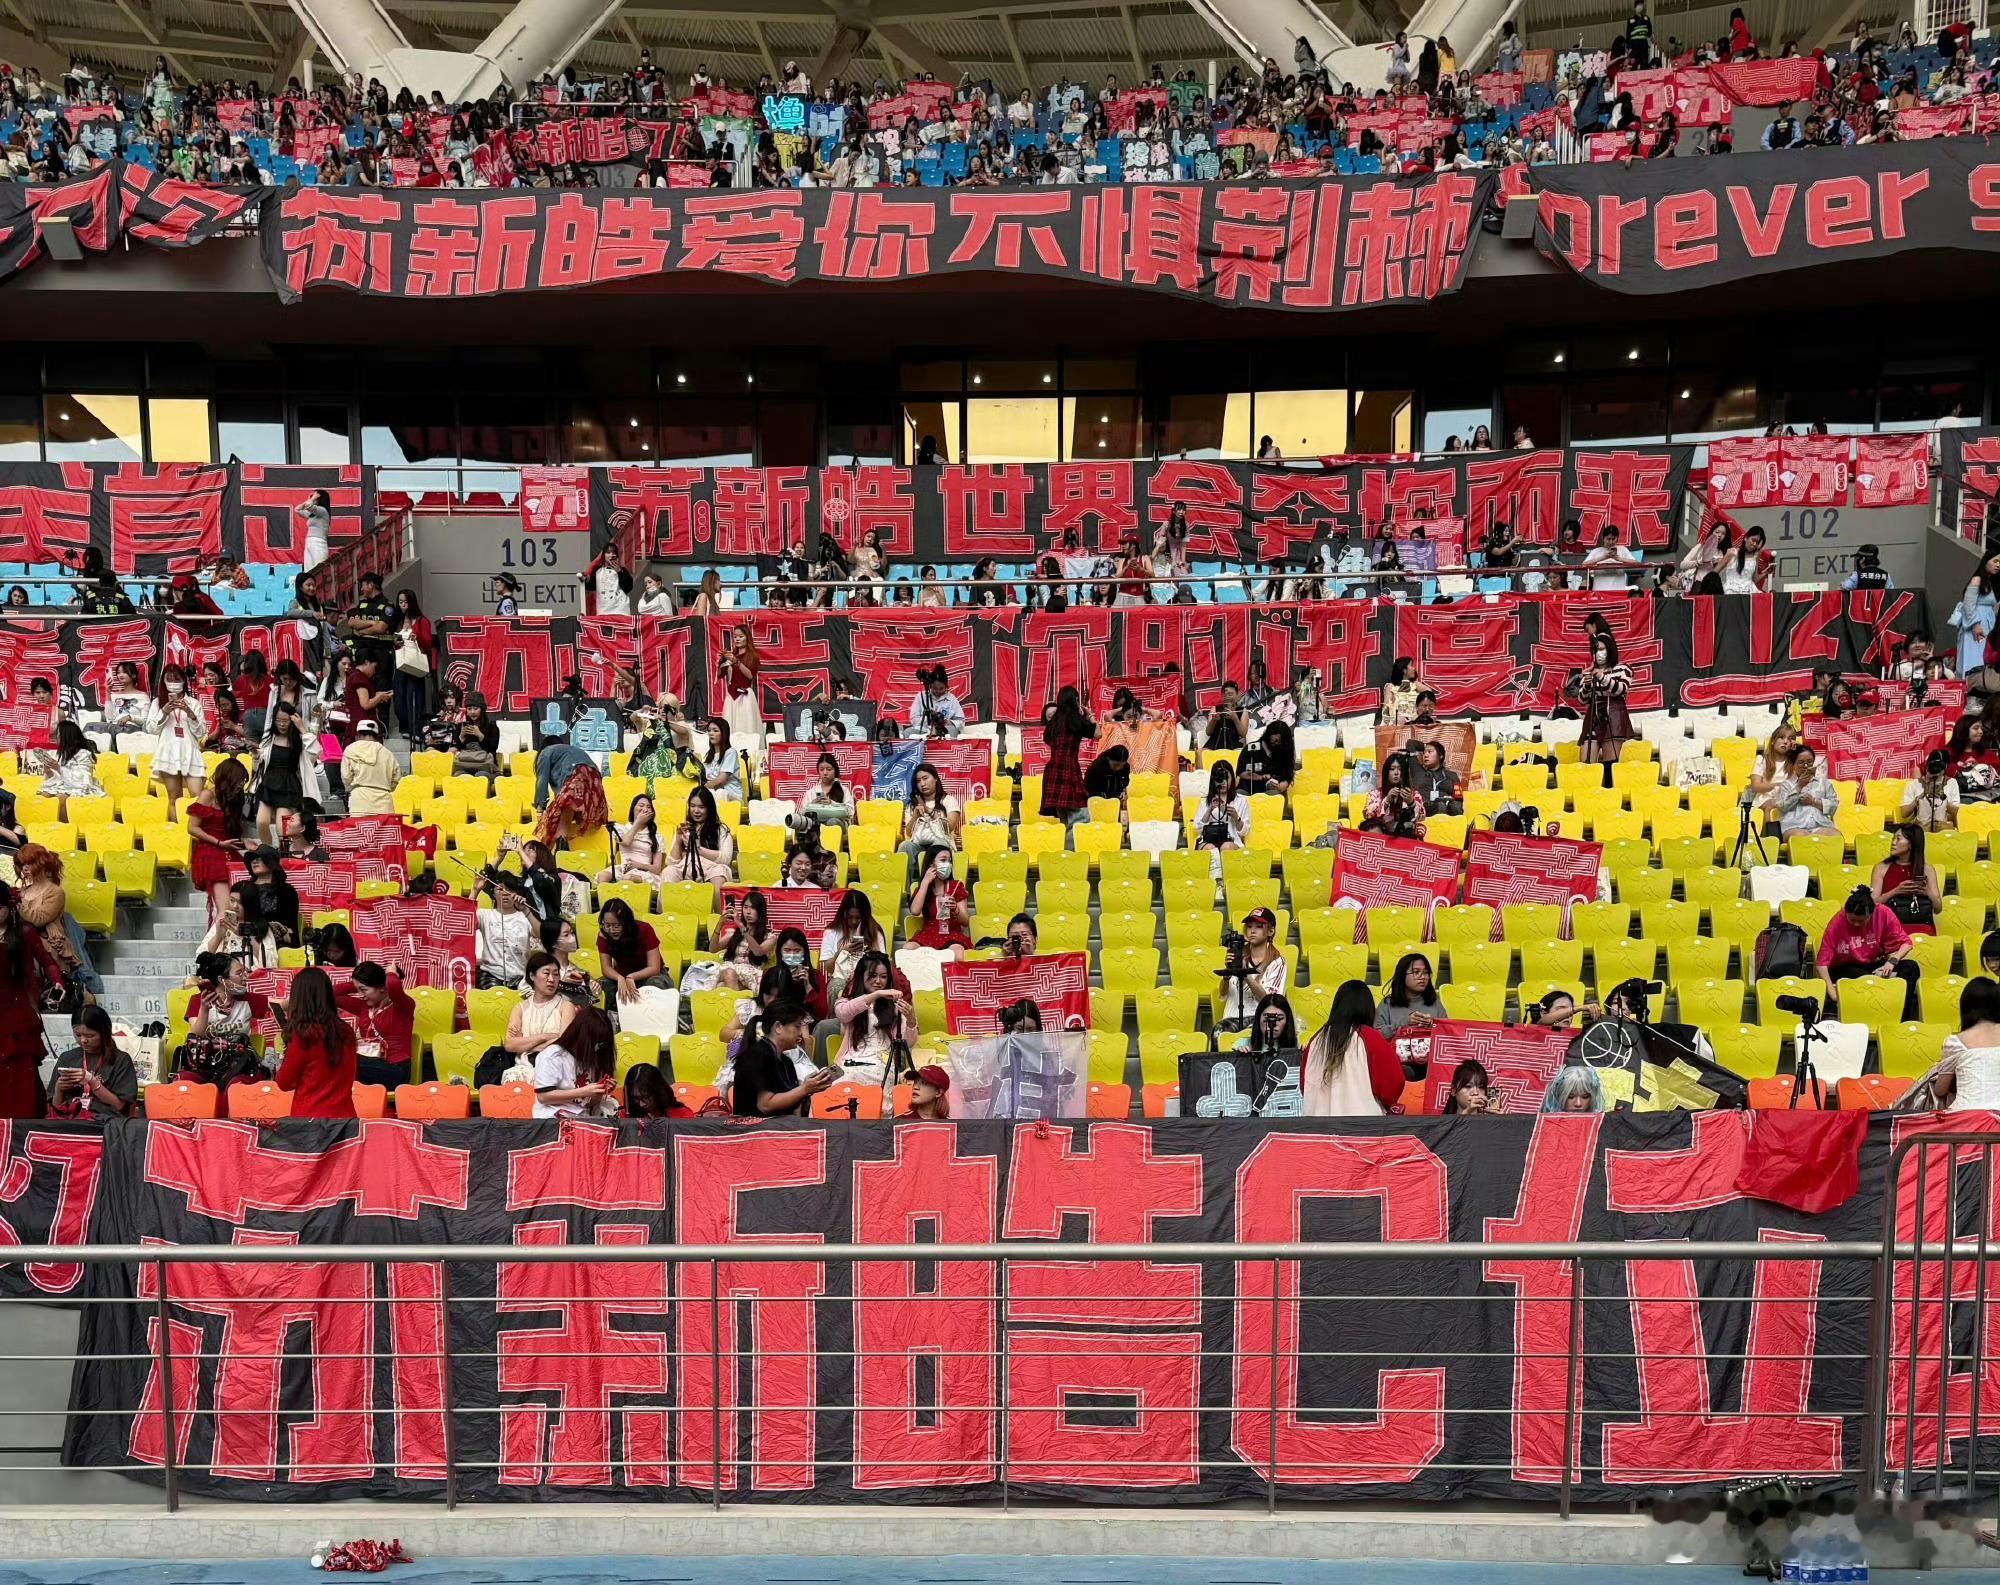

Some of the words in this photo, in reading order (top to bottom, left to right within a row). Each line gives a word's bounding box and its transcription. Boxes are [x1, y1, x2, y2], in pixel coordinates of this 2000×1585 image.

[281, 174, 1476, 307] 苏新皓爱你不惧荆棘
[1779, 508, 1839, 540] 102
[502, 538, 557, 567] 103
[535, 585, 577, 603] EXIT
[96, 603, 119, 616] 执勤
[135, 966, 162, 975] 32-16
[145, 1000, 161, 1012] 06
